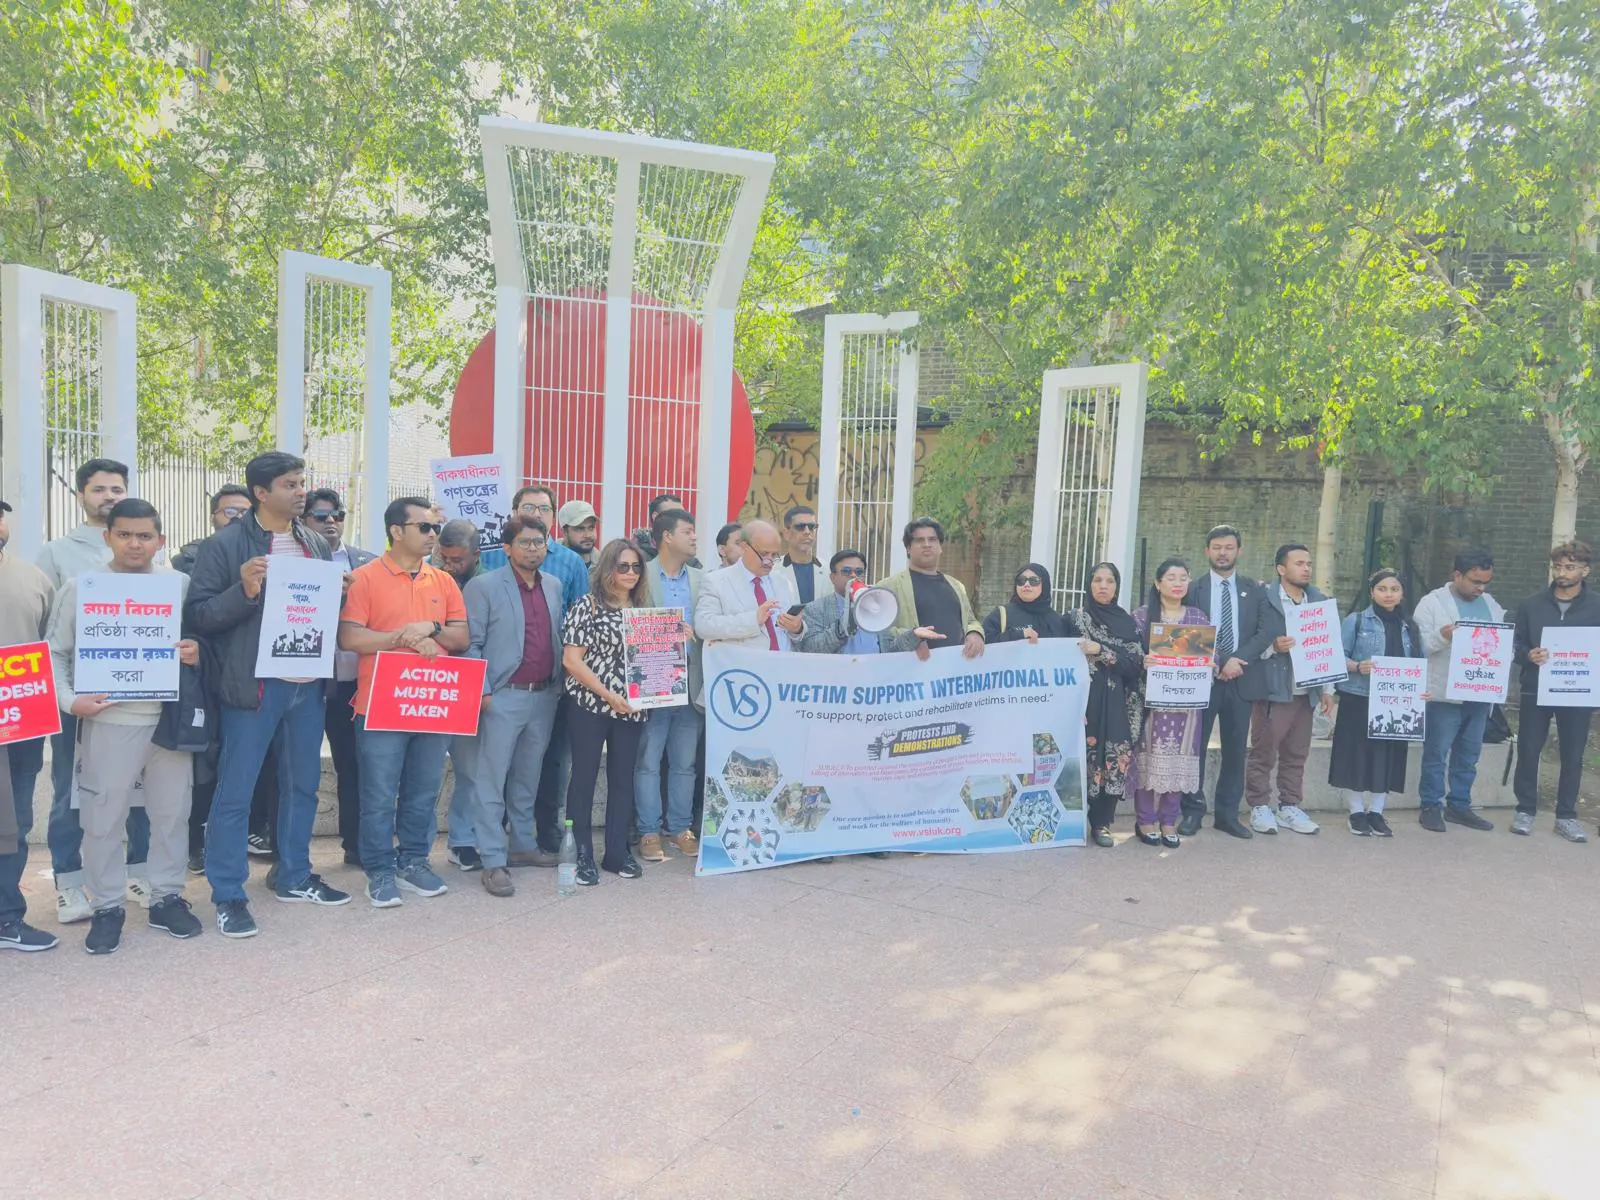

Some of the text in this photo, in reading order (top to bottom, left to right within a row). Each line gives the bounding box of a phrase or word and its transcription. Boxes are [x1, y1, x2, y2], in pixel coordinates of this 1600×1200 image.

[434, 465, 501, 483] বাকস্বাধীনতা
[443, 484, 499, 500] গণতন্ত্রের
[83, 598, 173, 617] ন্যায় বিচার
[84, 621, 128, 638] প্রতিষ্ঠা
[629, 616, 643, 626] WE
[79, 648, 175, 662] মানবতা রক্ষা
[111, 669, 144, 684] করো
[400, 667, 459, 684] ACTION
[394, 685, 459, 702] MUST BE
[777, 667, 1077, 706] VICTIM SUPPORT INTERNATIONAL UK
[400, 704, 449, 719] TAKEN
[817, 709, 864, 723] support,
[865, 711, 904, 724] protect
[905, 708, 924, 719] and
[925, 700, 973, 717] rehabilitate
[974, 696, 1006, 708] victims
[1008, 694, 1018, 704] in
[901, 724, 957, 742] PROTESTS AND
[893, 734, 962, 753] DEMONSTRATIONS
